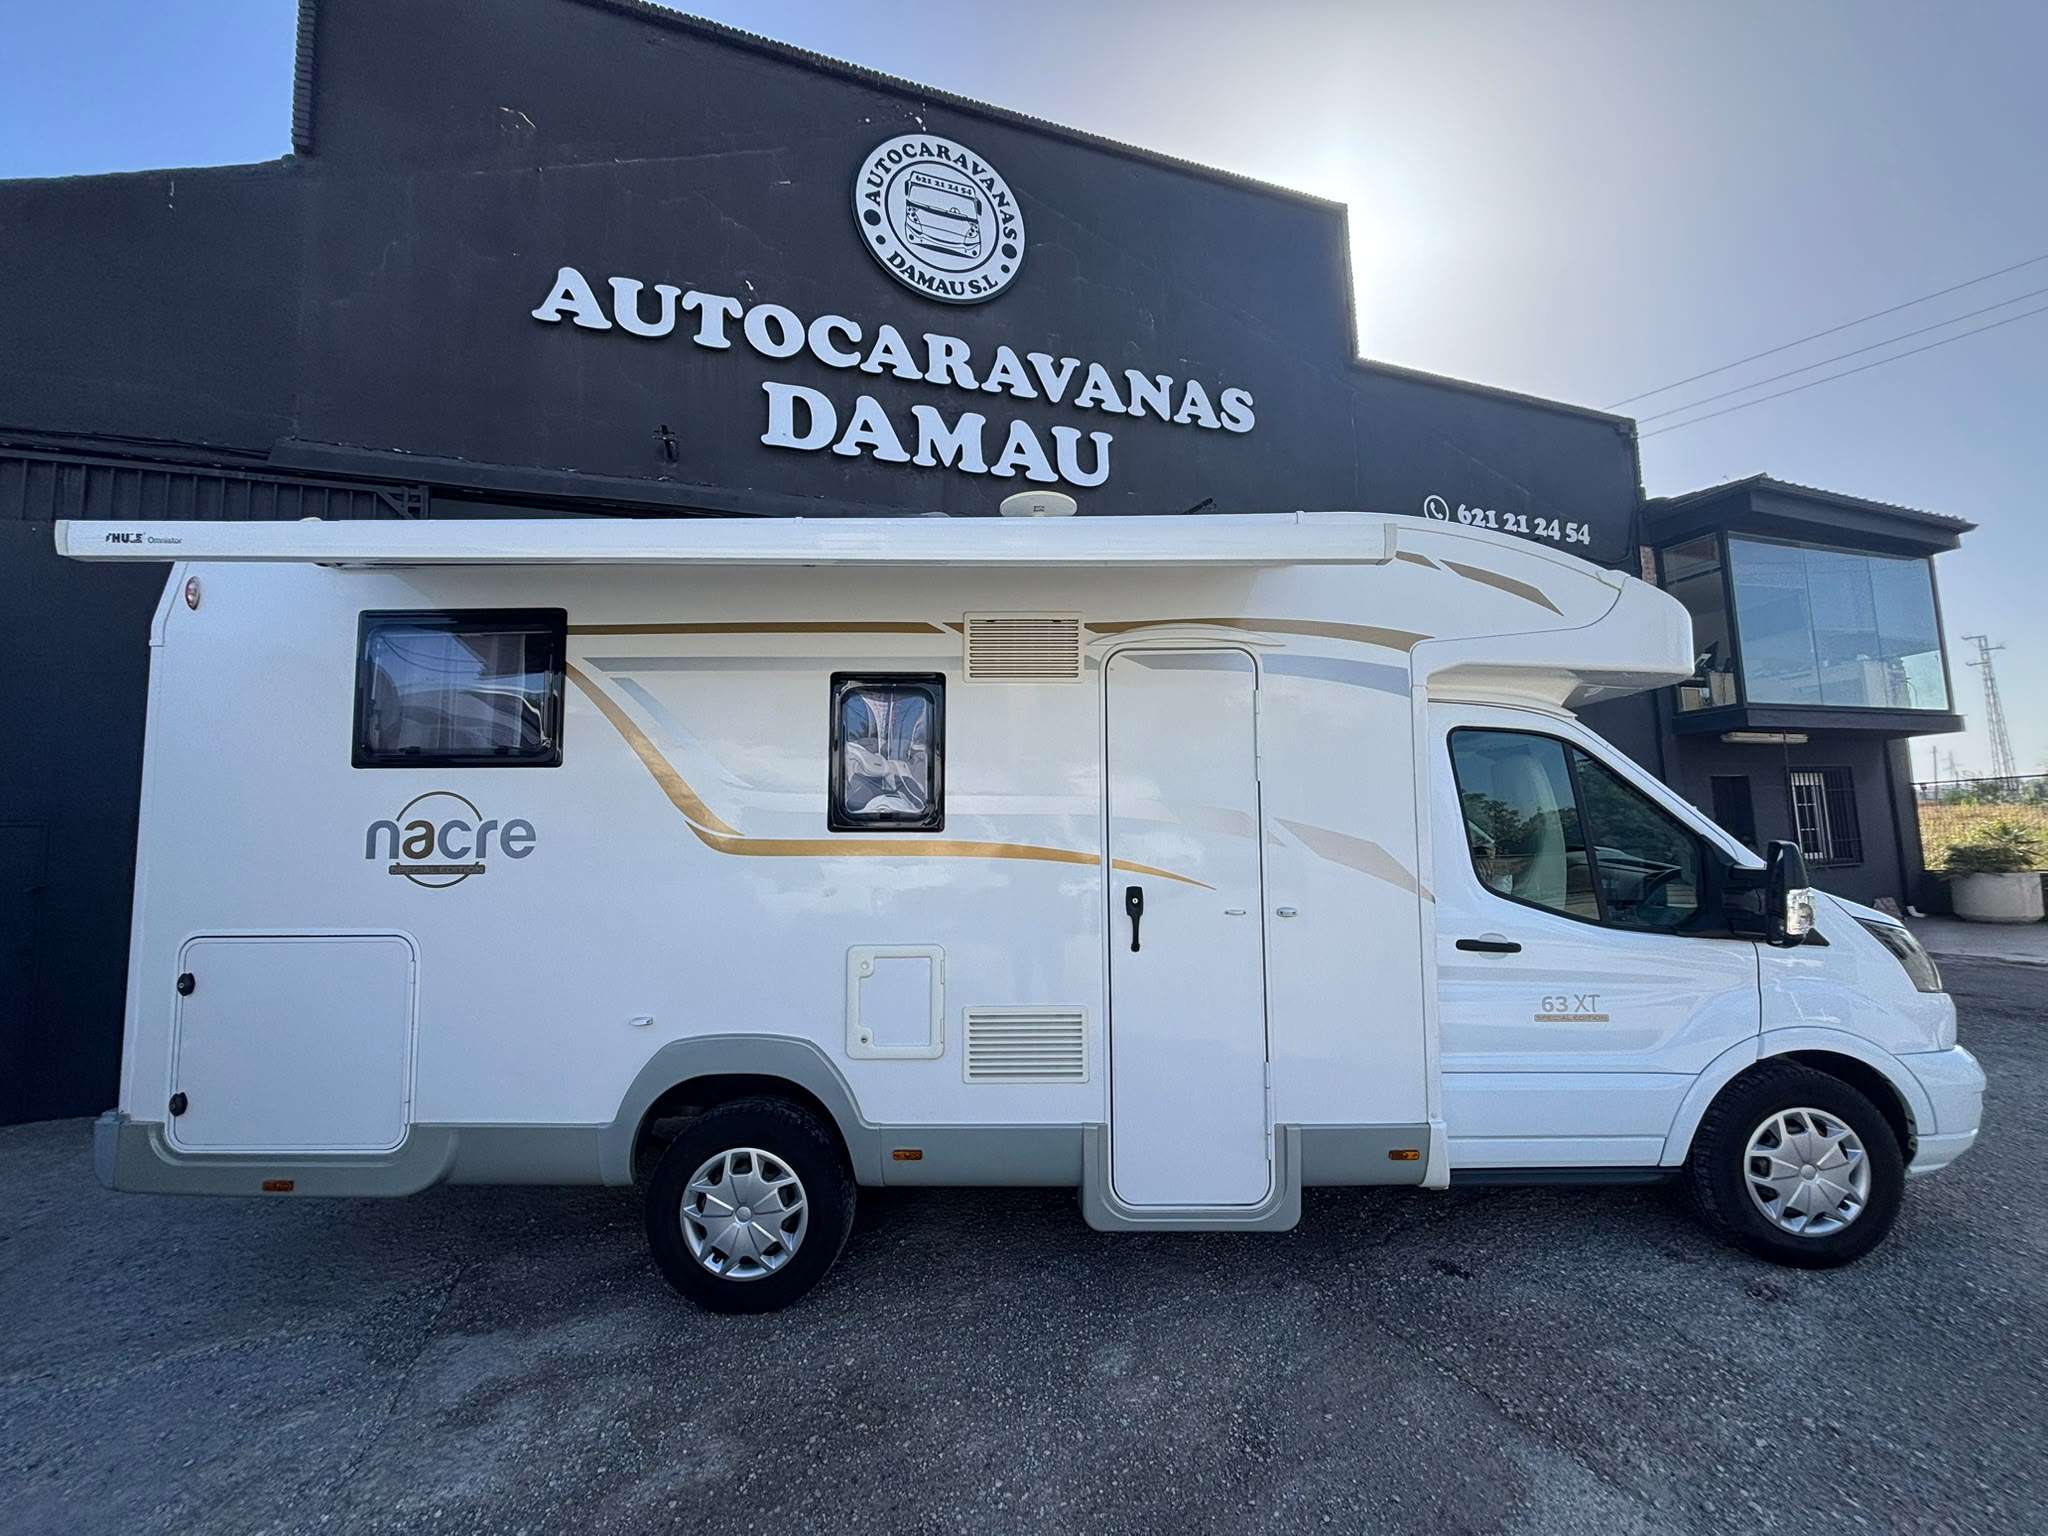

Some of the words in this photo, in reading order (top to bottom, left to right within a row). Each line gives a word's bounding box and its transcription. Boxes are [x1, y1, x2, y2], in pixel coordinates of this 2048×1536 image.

[865, 142, 1017, 240] AUTOCARAVANAS
[915, 175, 932, 184] 621
[934, 180, 945, 188] 21
[947, 184, 959, 192] 24
[960, 187, 972, 195] 54
[887, 251, 965, 295] DAMAU
[531, 266, 1256, 434] AUTOCARAVANAS
[760, 381, 1113, 488] DAMAU
[1457, 504, 1499, 529] 621
[1503, 512, 1530, 533] 21
[1534, 517, 1561, 541] 24
[1565, 522, 1591, 545] 54
[365, 818, 536, 860] nacre
[1541, 996, 1568, 1012] 63
[1573, 994, 1601, 1012] XT
